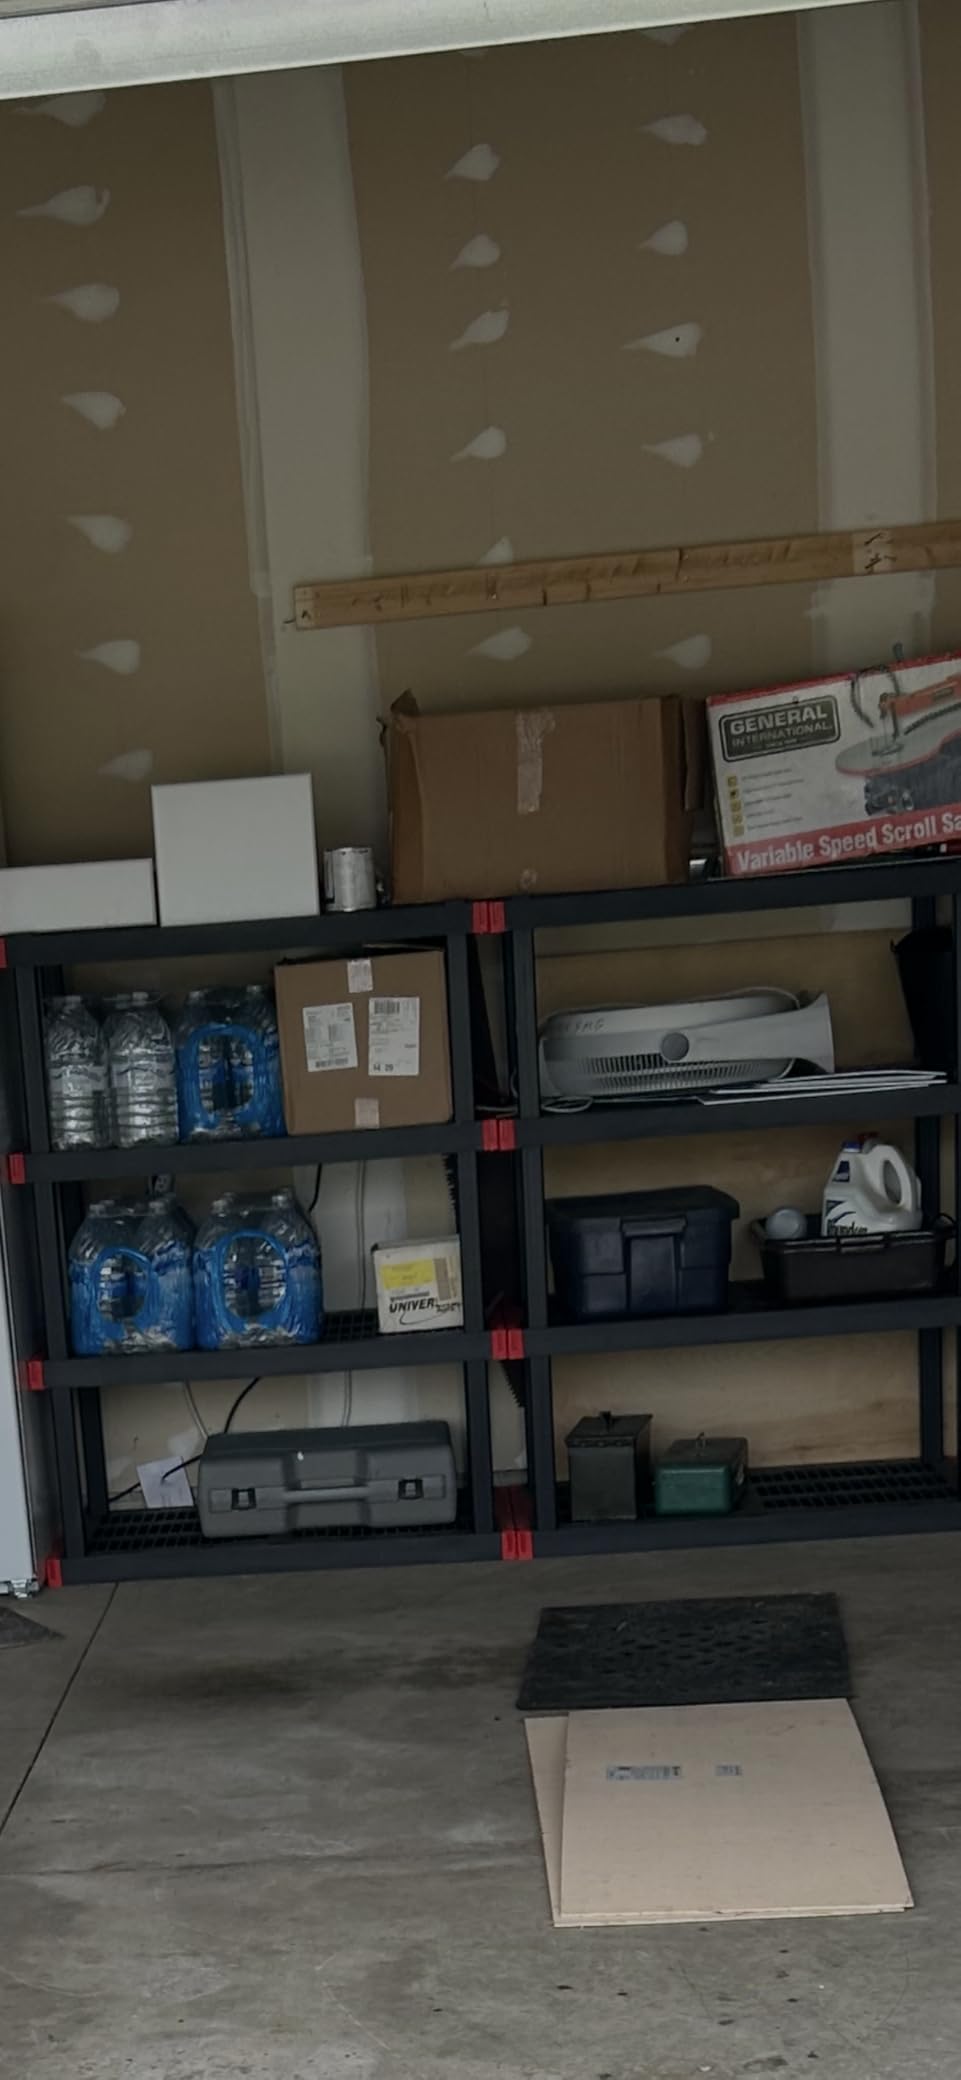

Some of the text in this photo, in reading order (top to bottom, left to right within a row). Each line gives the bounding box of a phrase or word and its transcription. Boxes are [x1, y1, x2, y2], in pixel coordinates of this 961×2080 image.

[730, 705, 828, 735] GENERAL
[737, 840, 814, 870] Variable
[819, 828, 877, 859] Speed
[881, 817, 937, 844] Scroll
